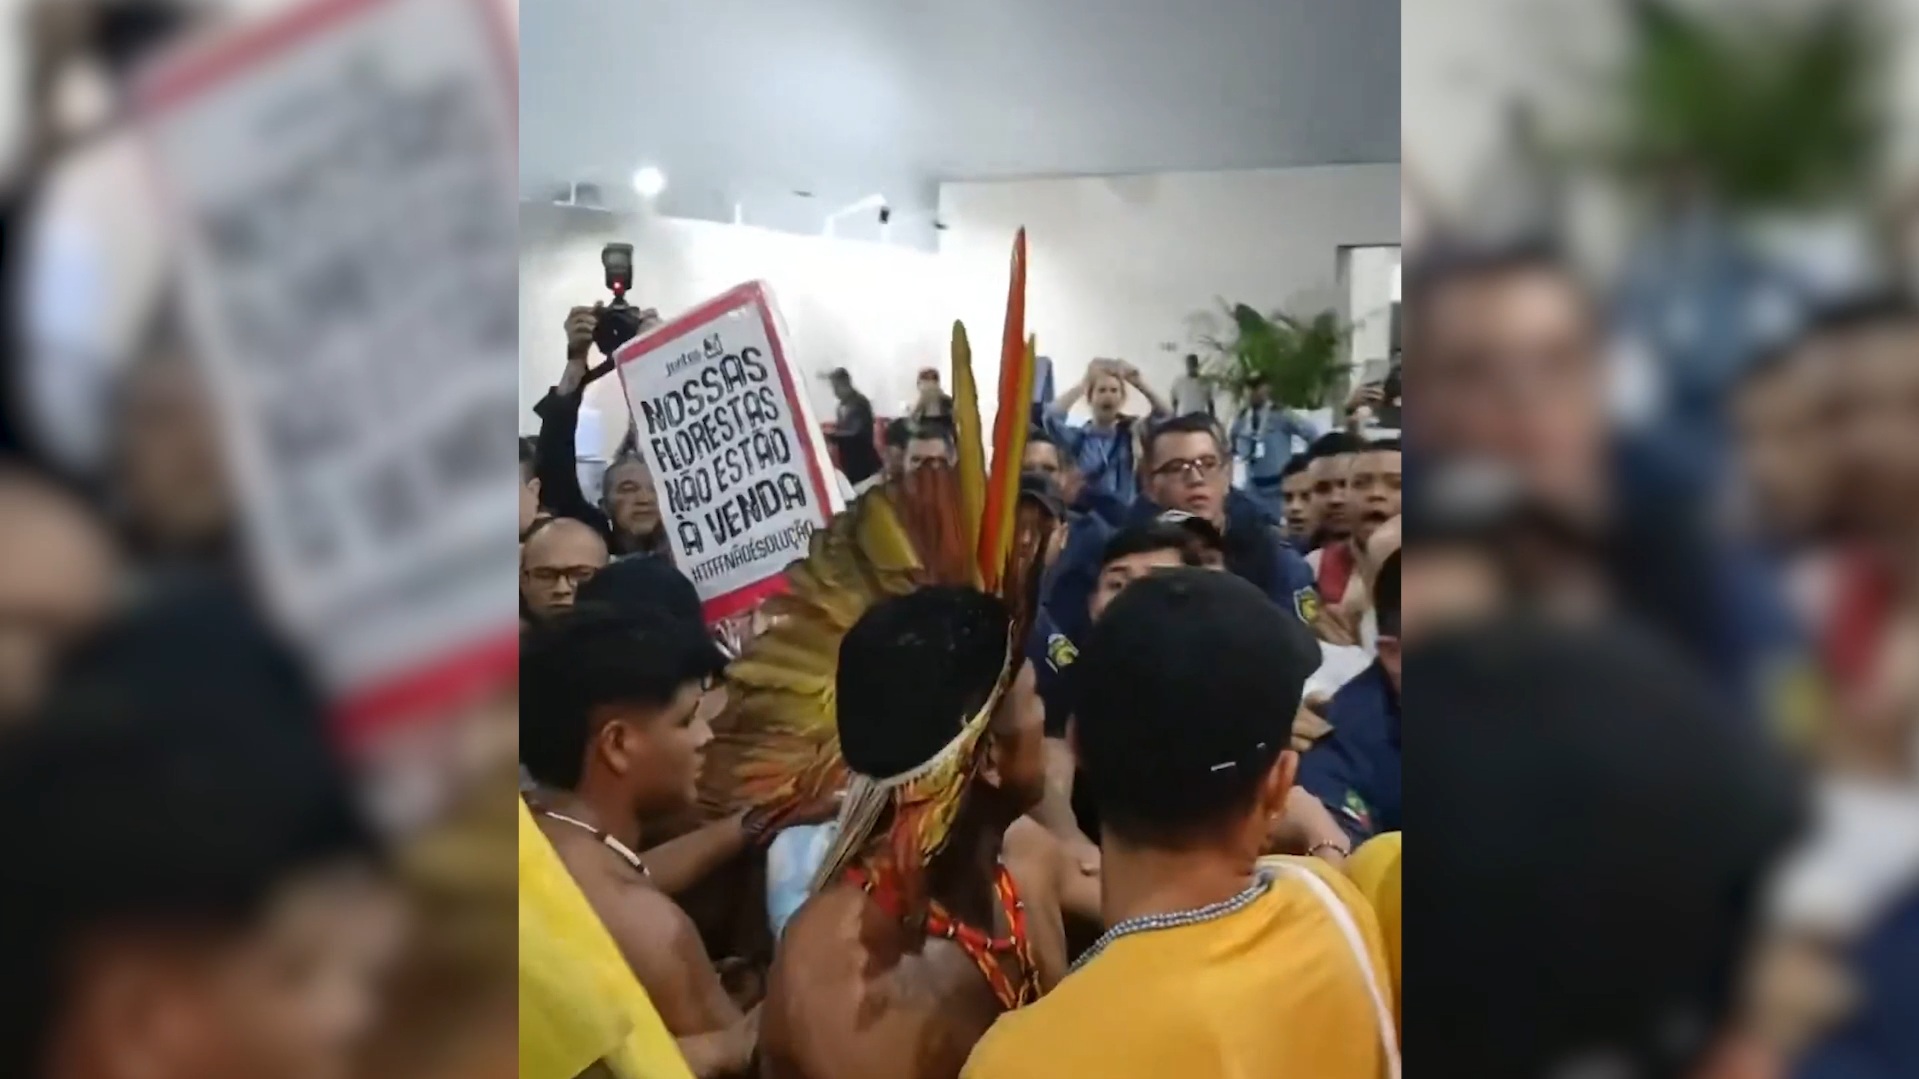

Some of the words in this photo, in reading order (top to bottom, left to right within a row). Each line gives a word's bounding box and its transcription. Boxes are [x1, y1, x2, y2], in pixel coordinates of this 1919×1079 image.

[641, 346, 768, 434] NOSSAS
[652, 387, 779, 473] FLORESTAS
[664, 470, 712, 514] NÃO
[713, 427, 791, 492] ESTÃO
[676, 514, 704, 556] À
[705, 472, 807, 546] VENDA
